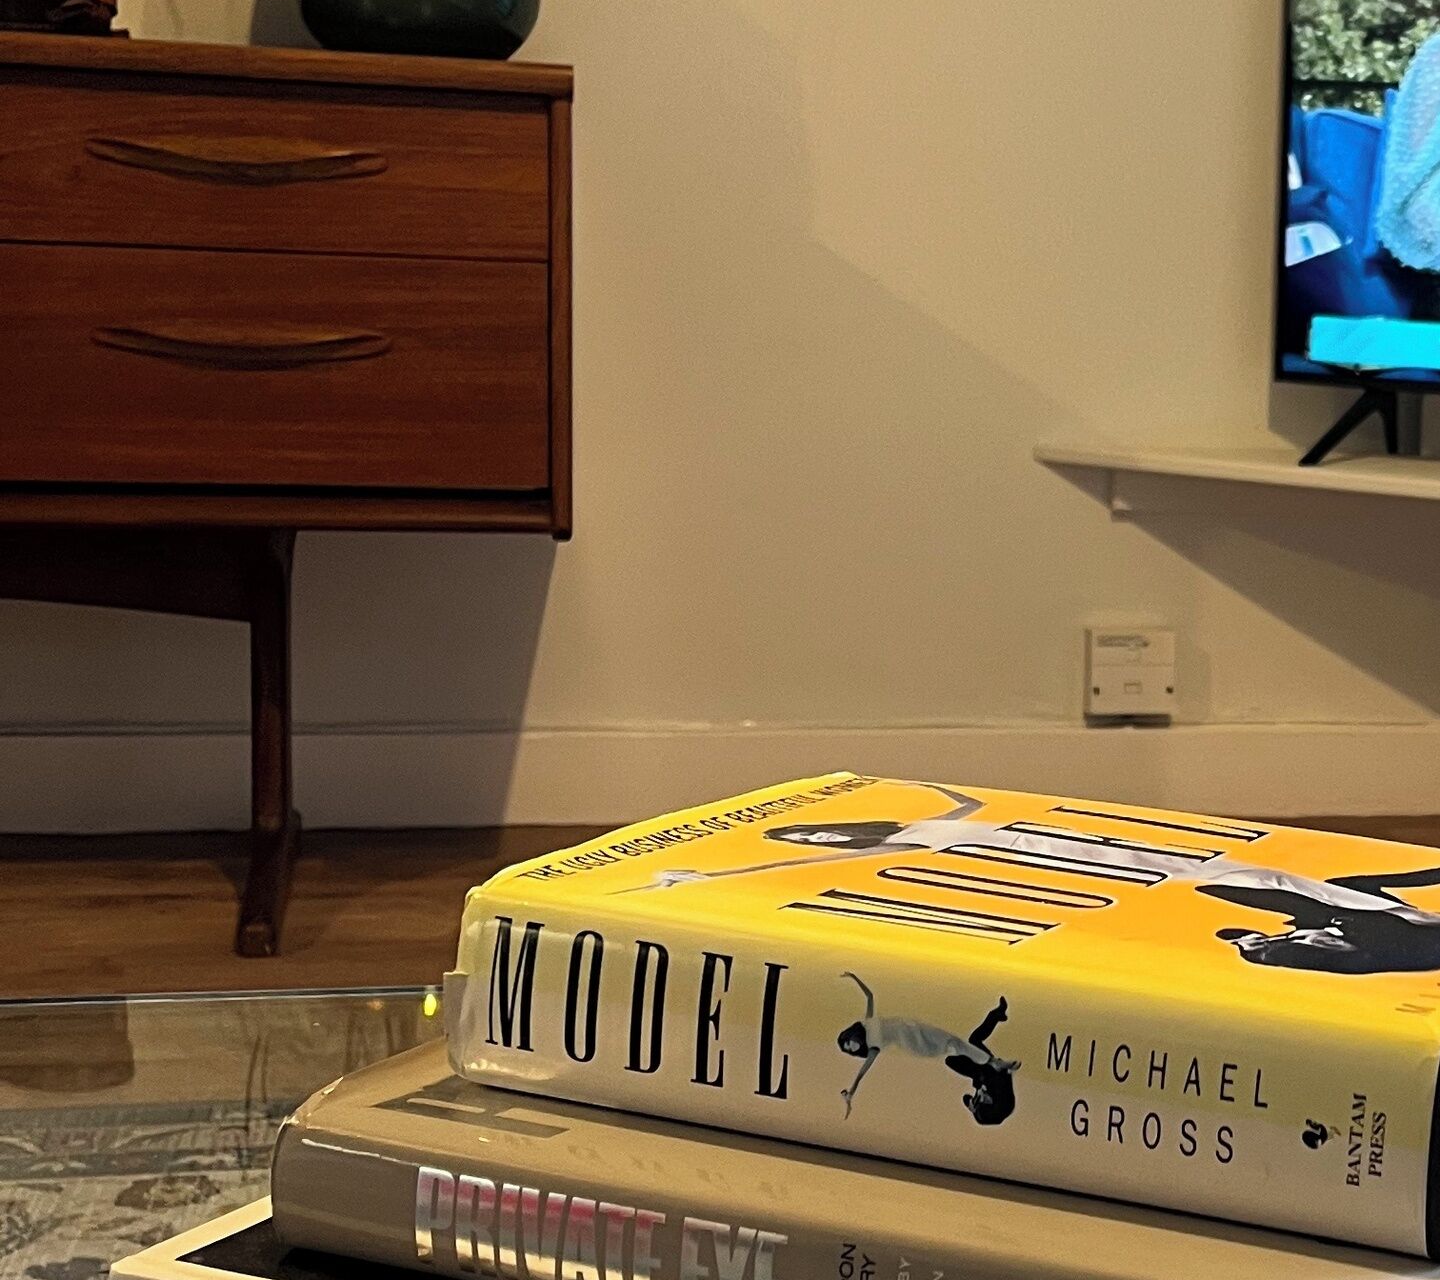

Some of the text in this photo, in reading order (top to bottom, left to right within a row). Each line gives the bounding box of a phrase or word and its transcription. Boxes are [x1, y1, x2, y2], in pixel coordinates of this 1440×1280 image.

[513, 864, 563, 882] THE
[558, 848, 624, 875] UGLY
[608, 823, 714, 857] BUSINESS
[700, 816, 734, 832] OF
[724, 793, 826, 823] BEAUTIFUL
[777, 804, 1270, 946] MODEL
[484, 915, 790, 1100] MODEL
[1046, 1032, 1269, 1109] MICHAEL
[1070, 1098, 1234, 1164] GROSS
[1345, 1092, 1368, 1187] BANTAM
[1367, 1111, 1387, 1178] PRESS
